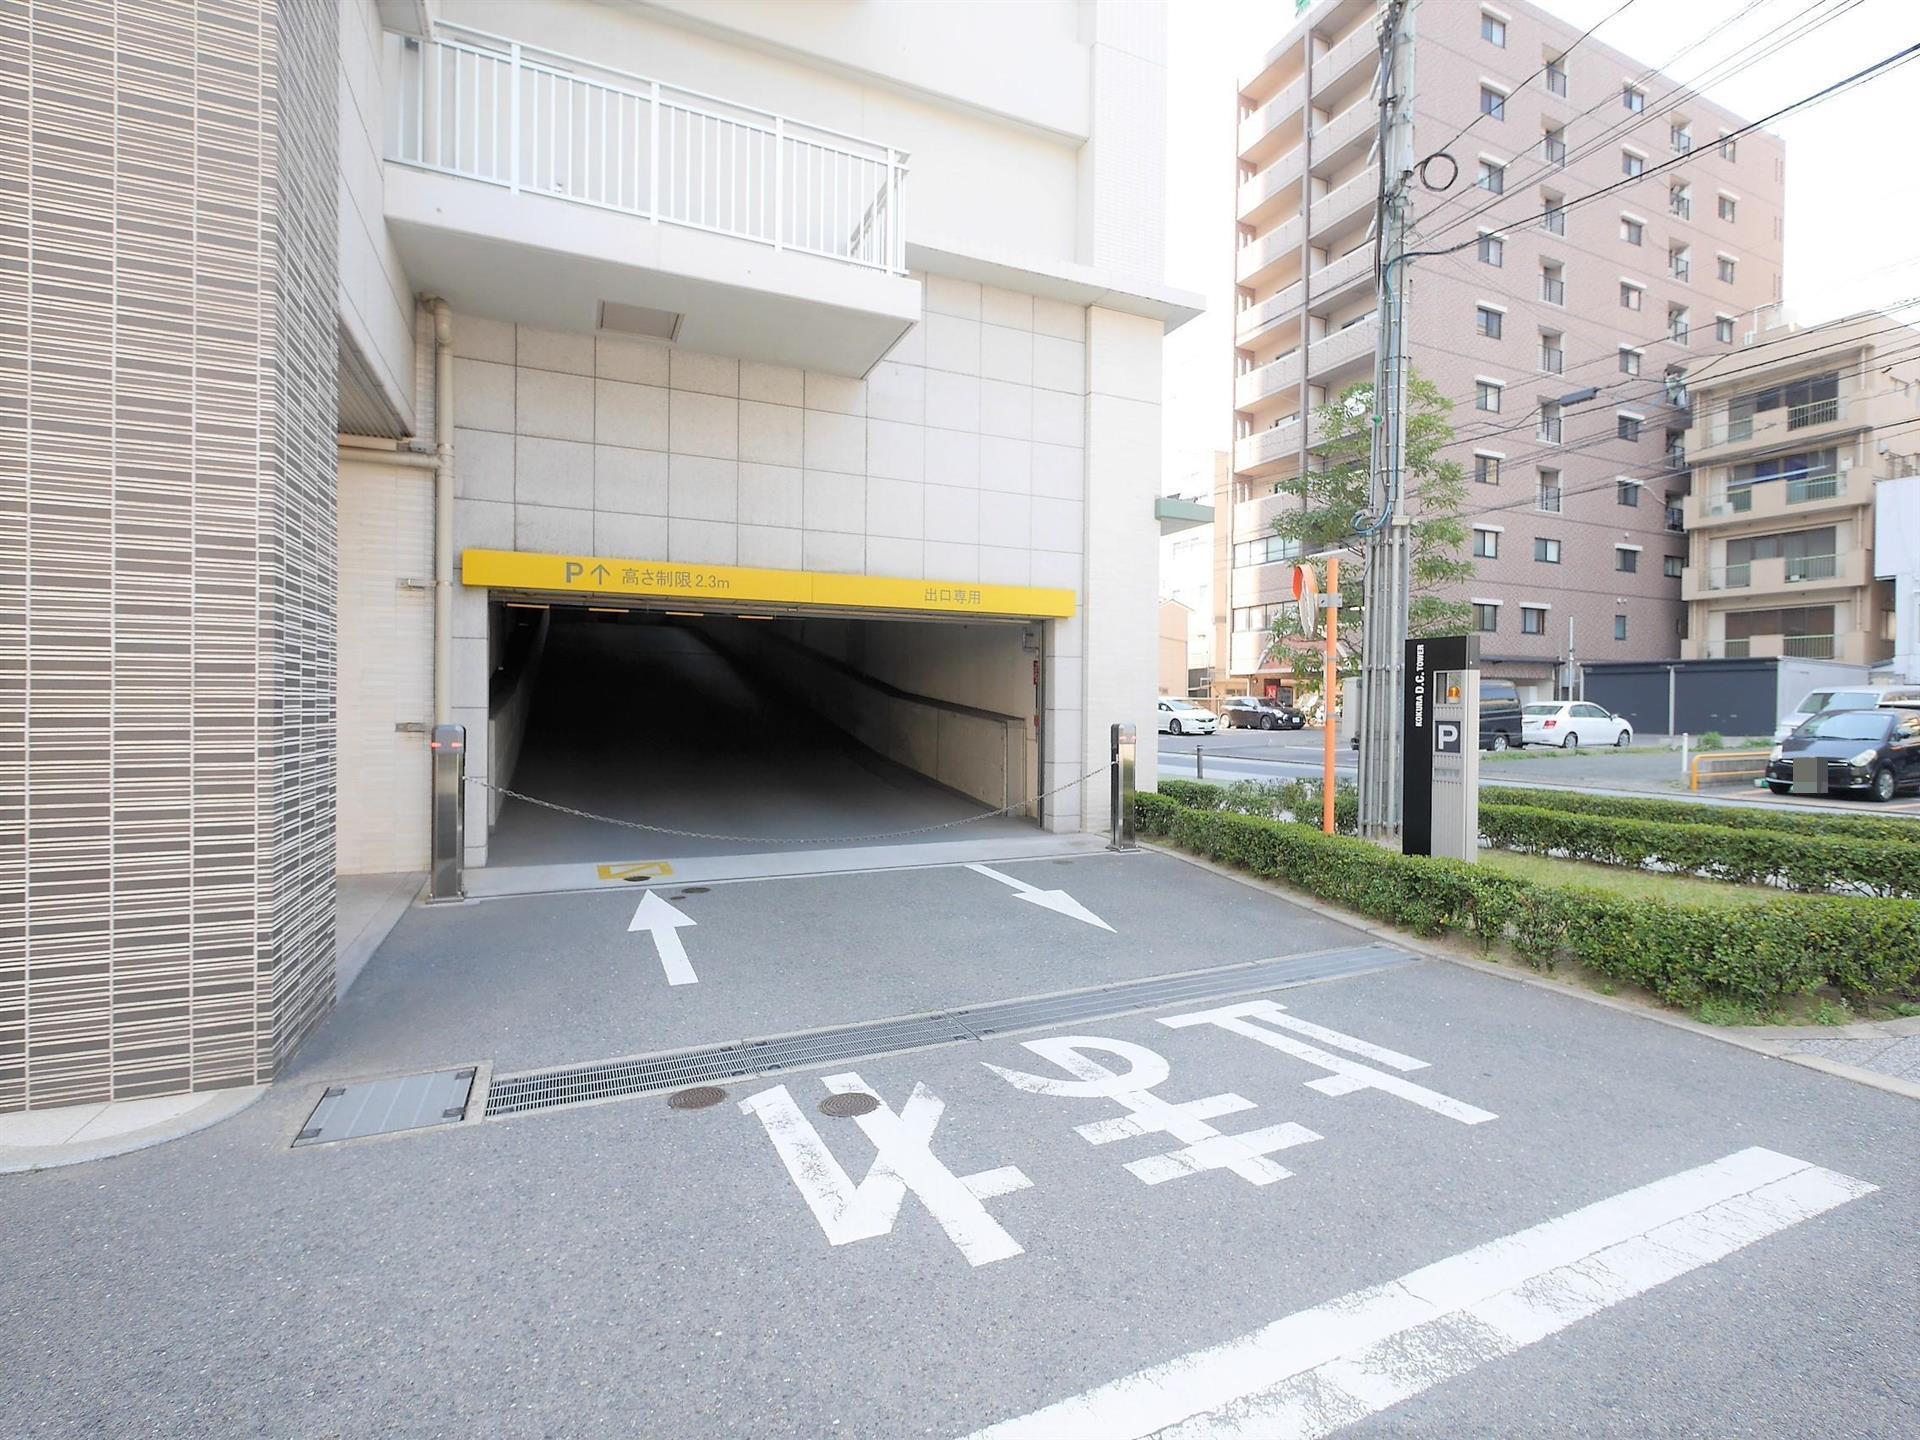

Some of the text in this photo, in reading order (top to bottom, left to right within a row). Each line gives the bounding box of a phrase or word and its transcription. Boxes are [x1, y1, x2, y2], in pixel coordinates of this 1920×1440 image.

[566, 562, 584, 583] P
[925, 588, 981, 604] 出口専用
[1415, 644, 1425, 727] KOKURA D.C. TOWER
[1438, 724, 1458, 750] P
